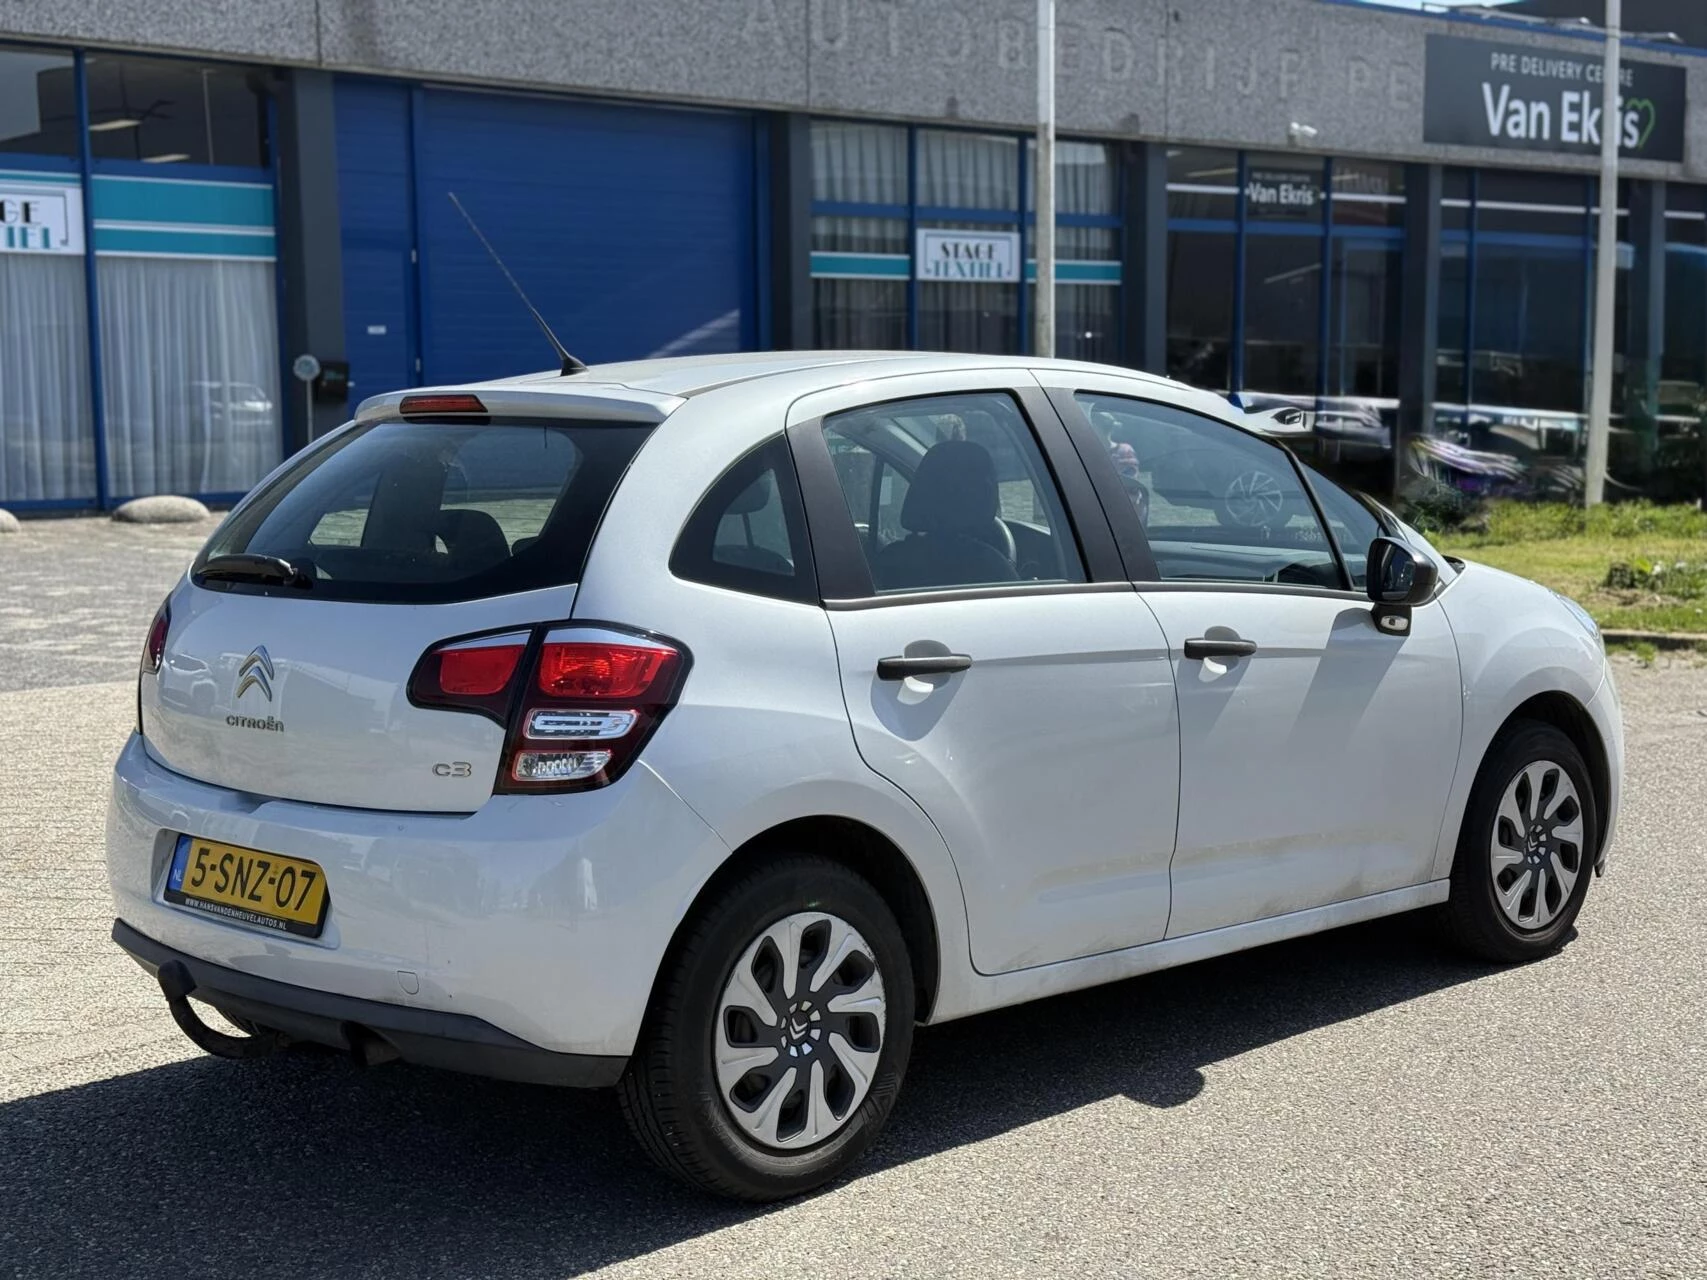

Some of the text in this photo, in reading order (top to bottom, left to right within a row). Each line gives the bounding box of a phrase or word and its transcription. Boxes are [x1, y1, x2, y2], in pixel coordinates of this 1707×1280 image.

[1490, 52, 1633, 87] PRE DELIVERY CERE
[1482, 82, 1640, 149] Van Ekis
[1248, 181, 1314, 206] Van Ekris
[940, 241, 997, 260] STAGE
[432, 761, 472, 778] C3
[172, 872, 183, 882] NL
[190, 847, 317, 911] 5-SNZ-07
[185, 897, 287, 931] WWW.HANSVANDENHEUVELAUTOS.NL
